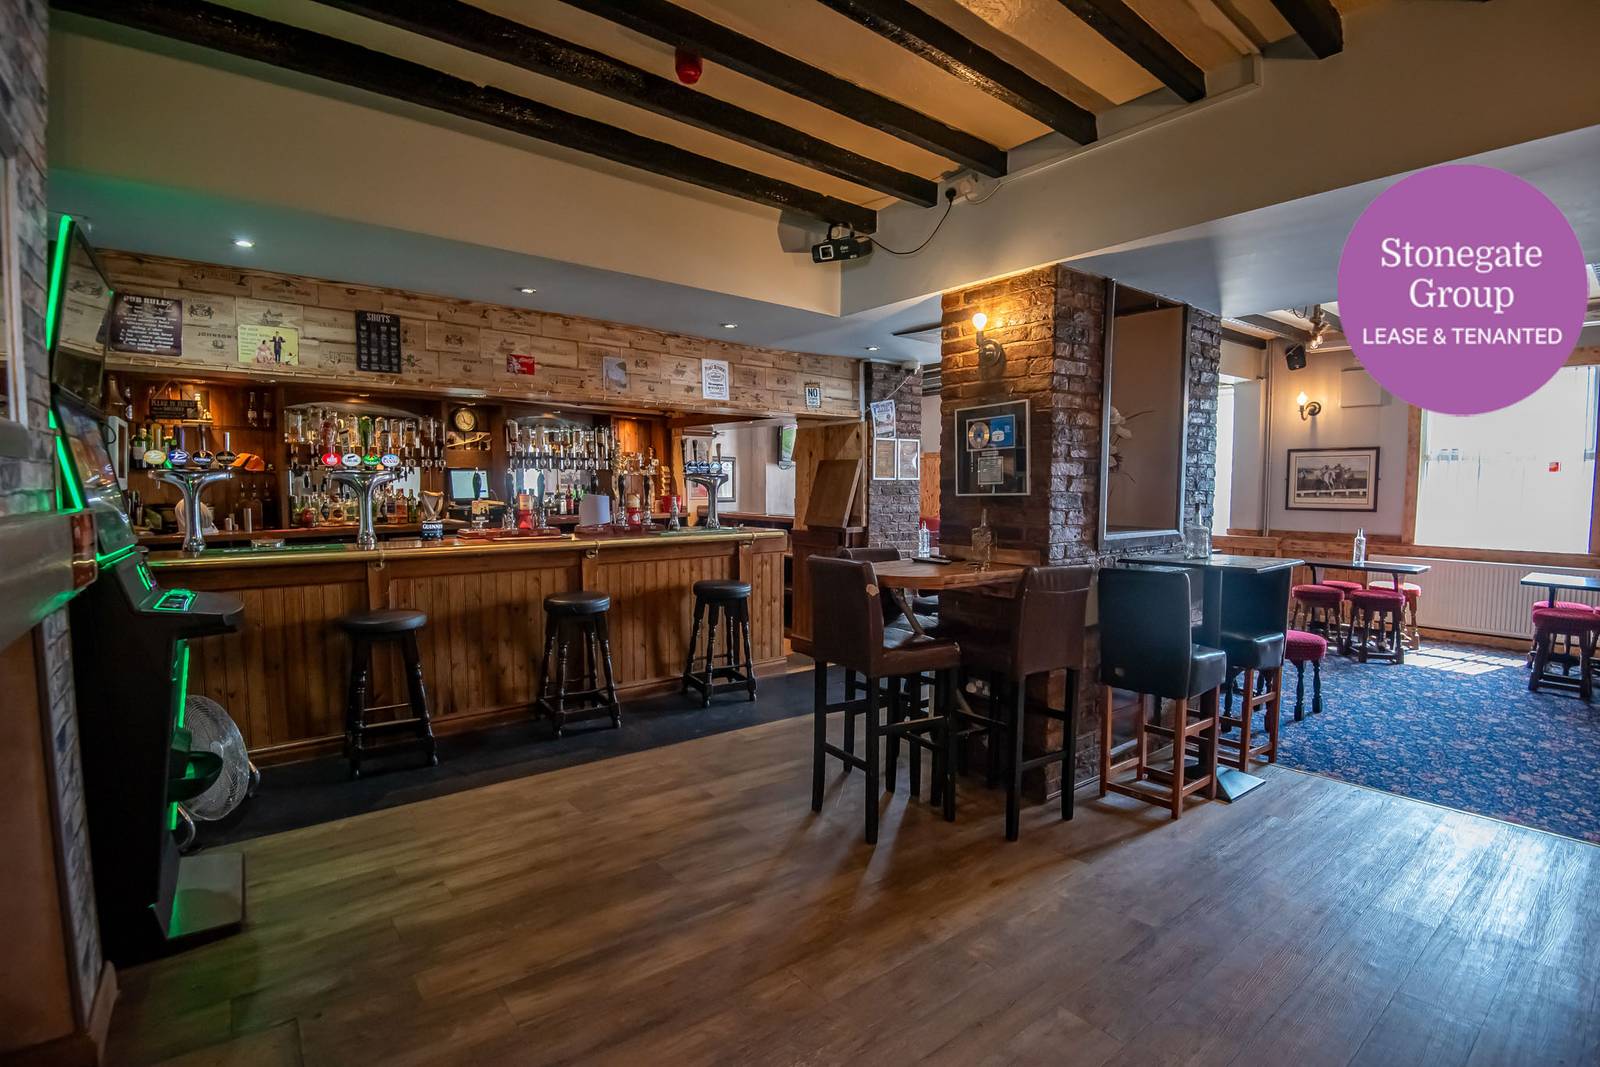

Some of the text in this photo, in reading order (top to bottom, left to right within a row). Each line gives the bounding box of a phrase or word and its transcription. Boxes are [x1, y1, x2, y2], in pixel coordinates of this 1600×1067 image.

[143, 297, 172, 307] RULES
[366, 312, 391, 323] SHOTS
[807, 388, 818, 398] NO
